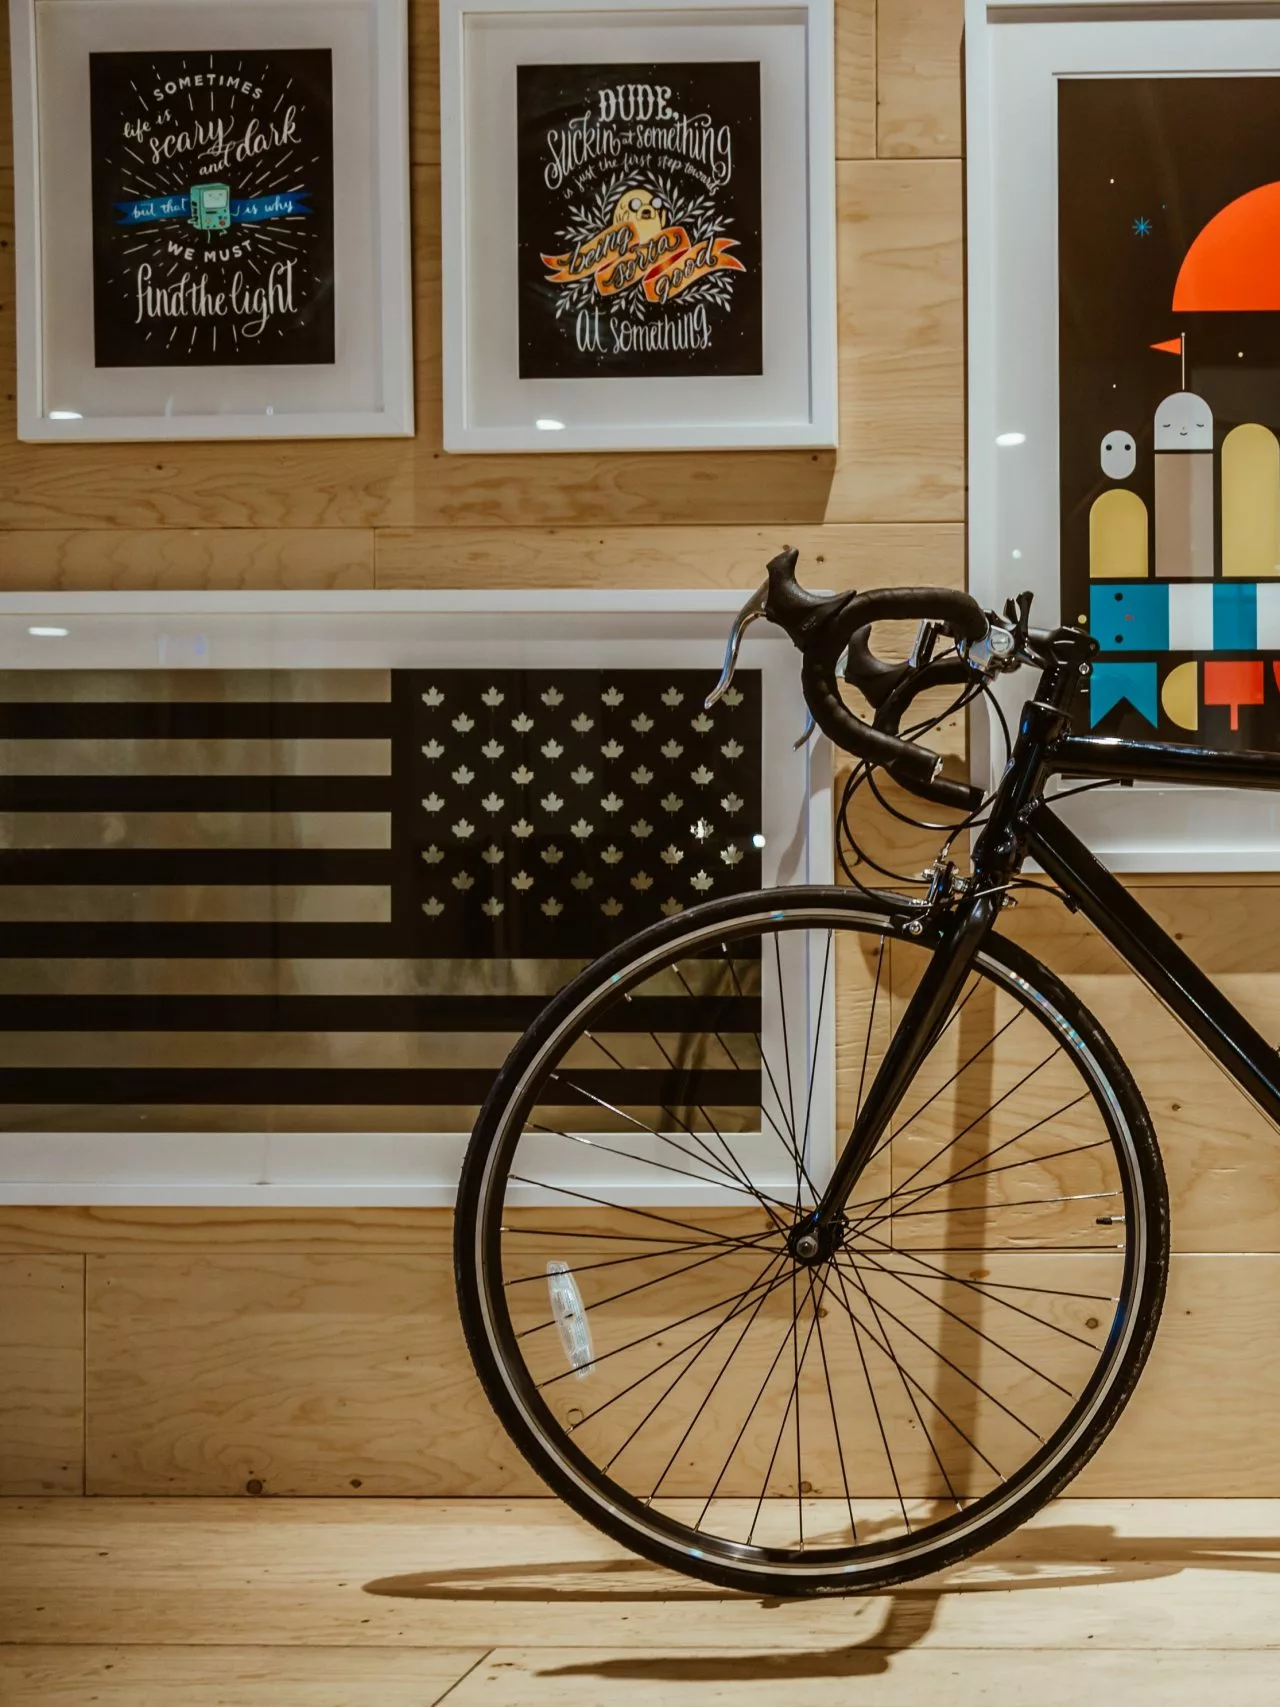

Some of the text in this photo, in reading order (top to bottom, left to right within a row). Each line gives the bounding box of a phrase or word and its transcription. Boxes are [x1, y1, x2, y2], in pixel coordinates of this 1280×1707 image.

[154, 73, 263, 101] SOMETIMES
[598, 84, 679, 121] DUDE,
[123, 109, 171, 143] life is
[150, 105, 302, 175] scary and dark
[619, 131, 636, 146] at
[636, 113, 731, 185] something
[563, 187, 574, 199] is
[574, 164, 597, 192] just
[599, 155, 618, 171] the
[621, 152, 651, 173] first
[658, 154, 682, 173] step
[133, 202, 157, 218] but
[160, 198, 188, 213] that
[243, 204, 258, 215] is
[264, 195, 295, 213] why
[167, 240, 252, 263] WE MUST
[568, 226, 634, 275] being
[655, 233, 718, 304] good
[135, 257, 298, 338] find the light
[575, 306, 607, 352] at
